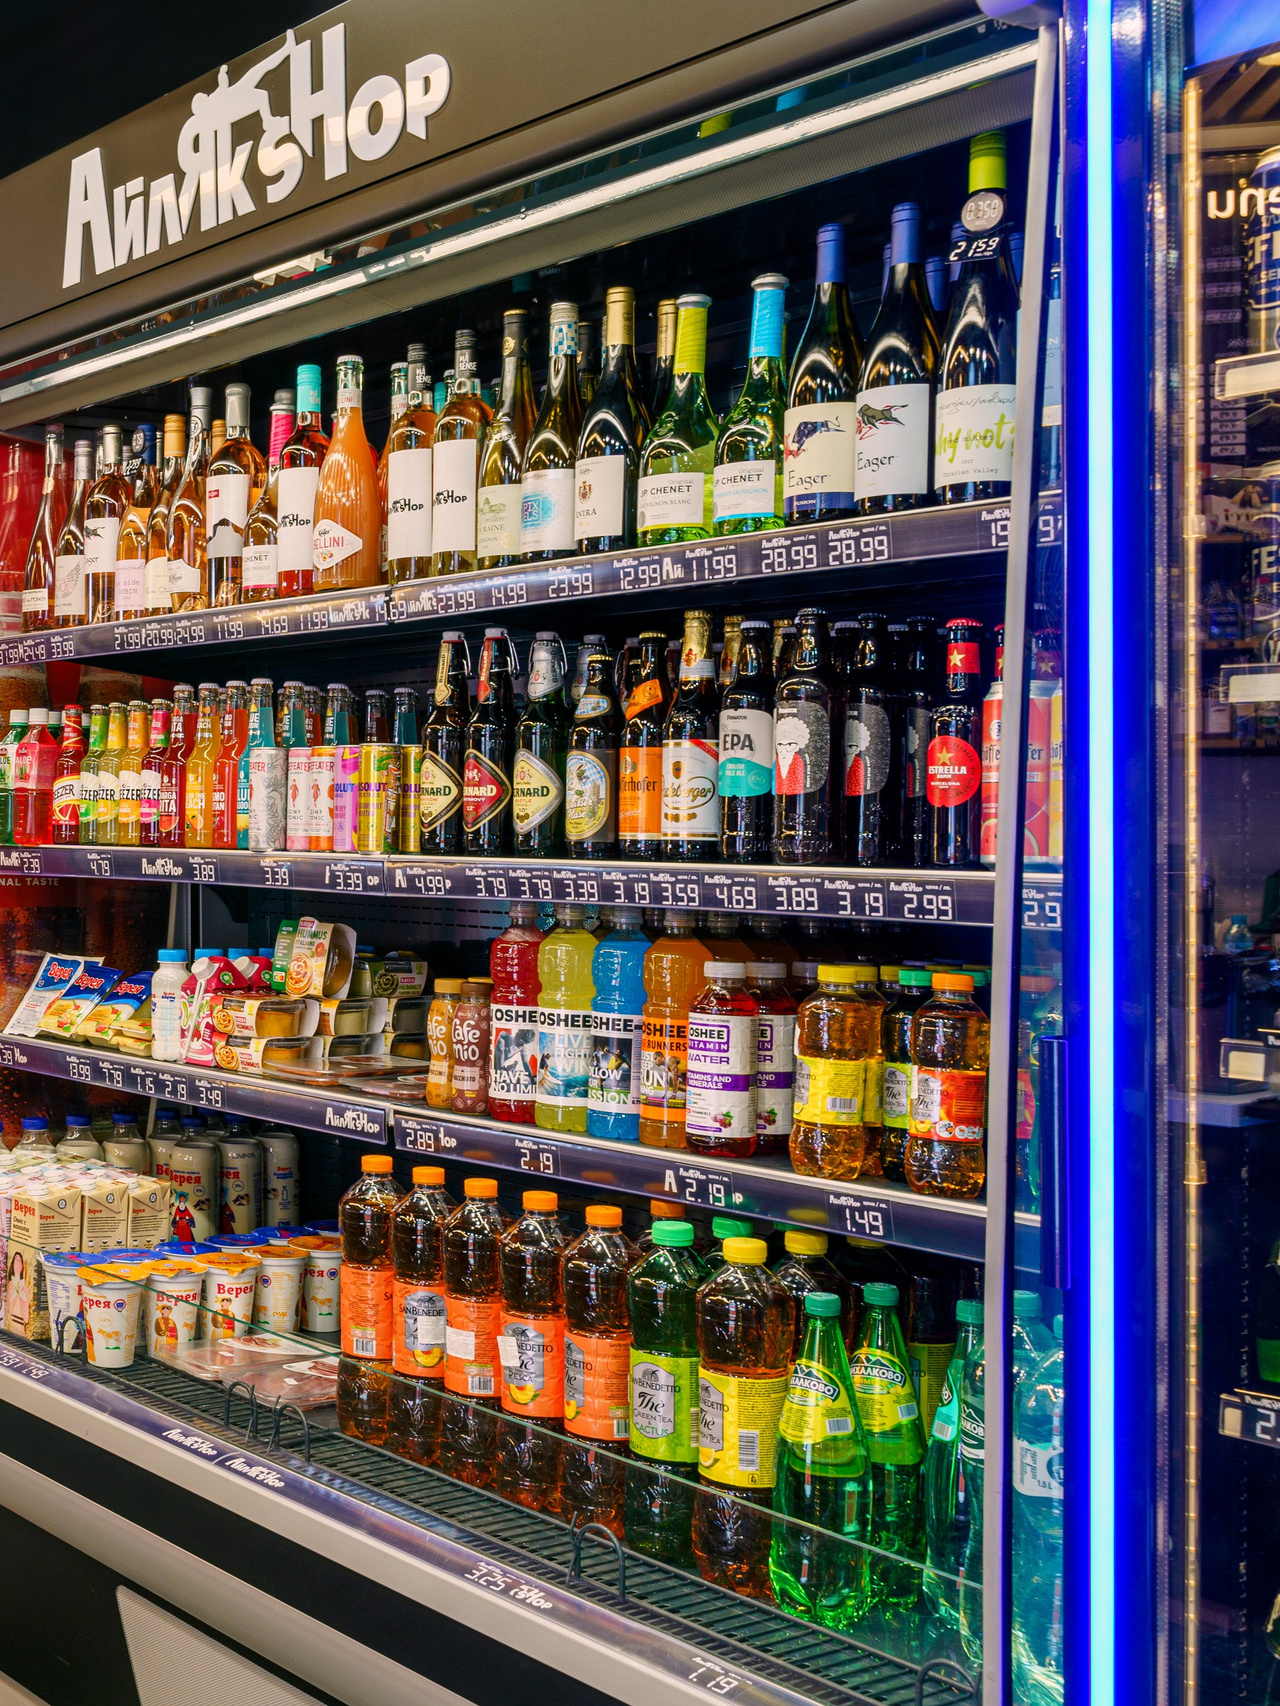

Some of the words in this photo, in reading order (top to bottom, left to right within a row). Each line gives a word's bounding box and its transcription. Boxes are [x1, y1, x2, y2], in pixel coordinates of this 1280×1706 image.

[857, 452, 895, 473] Eager
[972, 466, 999, 477] Valley
[721, 474, 762, 484] CHENET
[788, 470, 828, 491] Eager
[650, 485, 693, 496] CHENET
[762, 545, 817, 574] 28.99
[829, 536, 888, 567] 28.99
[621, 564, 661, 590] 12.99
[693, 555, 737, 581] 11.99
[492, 583, 527, 606] 14.99
[549, 572, 593, 598] 23.99
[437, 590, 476, 614] 23.99
[218, 621, 244, 640] 11.99
[300, 611, 329, 631] 11.99
[115, 631, 141, 650] 21.99
[146, 628, 175, 647] 20.99
[176, 625, 205, 645] 24.99
[51, 641, 75, 658] 33.99
[723, 733, 754, 752] EPA
[928, 765, 967, 776] ESTRELLA
[91, 859, 110, 876] 4.79
[193, 864, 215, 882] 3.89
[264, 868, 289, 886] 3.39
[25, 877, 60, 887] TASTE
[335, 872, 362, 891] 3.39
[415, 875, 445, 895] 4.99
[476, 877, 507, 898] 3.79
[519, 878, 553, 899] 3.79
[564, 880, 599, 901] 3.39
[613, 881, 650, 904] 3.19
[661, 883, 700, 906] 3.59
[716, 886, 757, 910] 4.69
[775, 887, 819, 911] 3.89
[838, 891, 884, 917] 3.19
[904, 894, 952, 920] 2.99
[296, 929, 328, 942] HUMMUS
[494, 1008, 538, 1024] OSHE
[539, 1011, 592, 1028] OSHEE
[592, 1016, 634, 1033] SHEE
[642, 1024, 687, 1039] OSHEE
[689, 1028, 725, 1040] OSHEE
[647, 1040, 687, 1052] RUNNERS
[70, 1063, 91, 1082] 13.99
[105, 1068, 122, 1087] 7.79
[712, 1075, 732, 1083] AND
[165, 1082, 187, 1101] 2.19
[199, 1087, 222, 1107] 3.49
[406, 1128, 434, 1152] 2.89
[520, 1149, 554, 1174] 2.19
[685, 1178, 725, 1207] 2.19
[14, 1199, 36, 1217] Верея
[845, 1207, 884, 1237] 1.49
[217, 1282, 254, 1299] Верея
[657, 1414, 673, 1424] TEA
[464, 1566, 513, 1592] 3.25
[688, 1667, 739, 1695] 1.19
